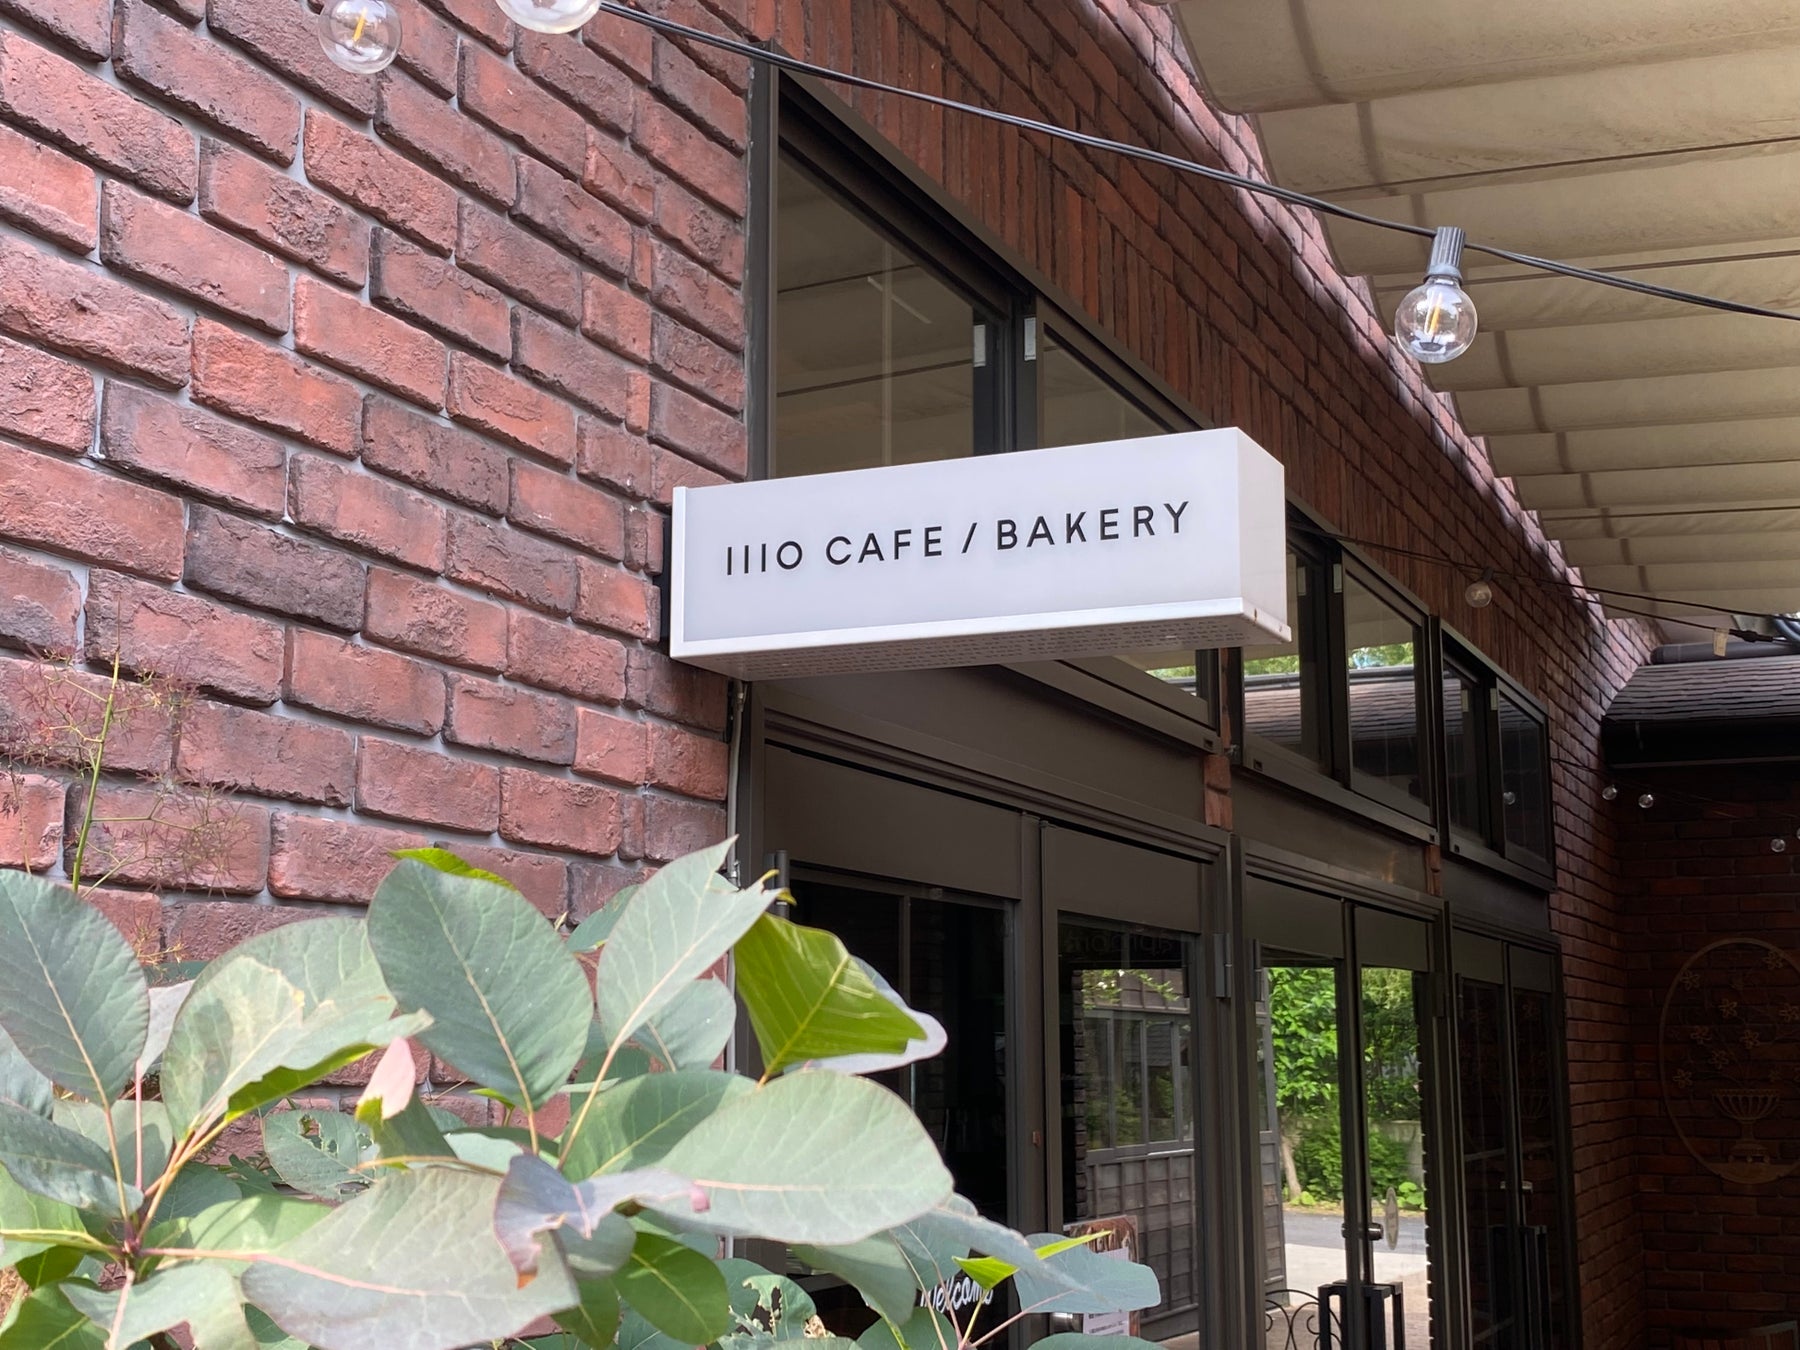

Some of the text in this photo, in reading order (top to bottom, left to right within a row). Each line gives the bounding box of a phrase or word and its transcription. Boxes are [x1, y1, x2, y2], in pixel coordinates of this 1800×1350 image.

[825, 522, 943, 567] CAFE
[961, 522, 978, 554] /
[997, 501, 1189, 551] BAKERY
